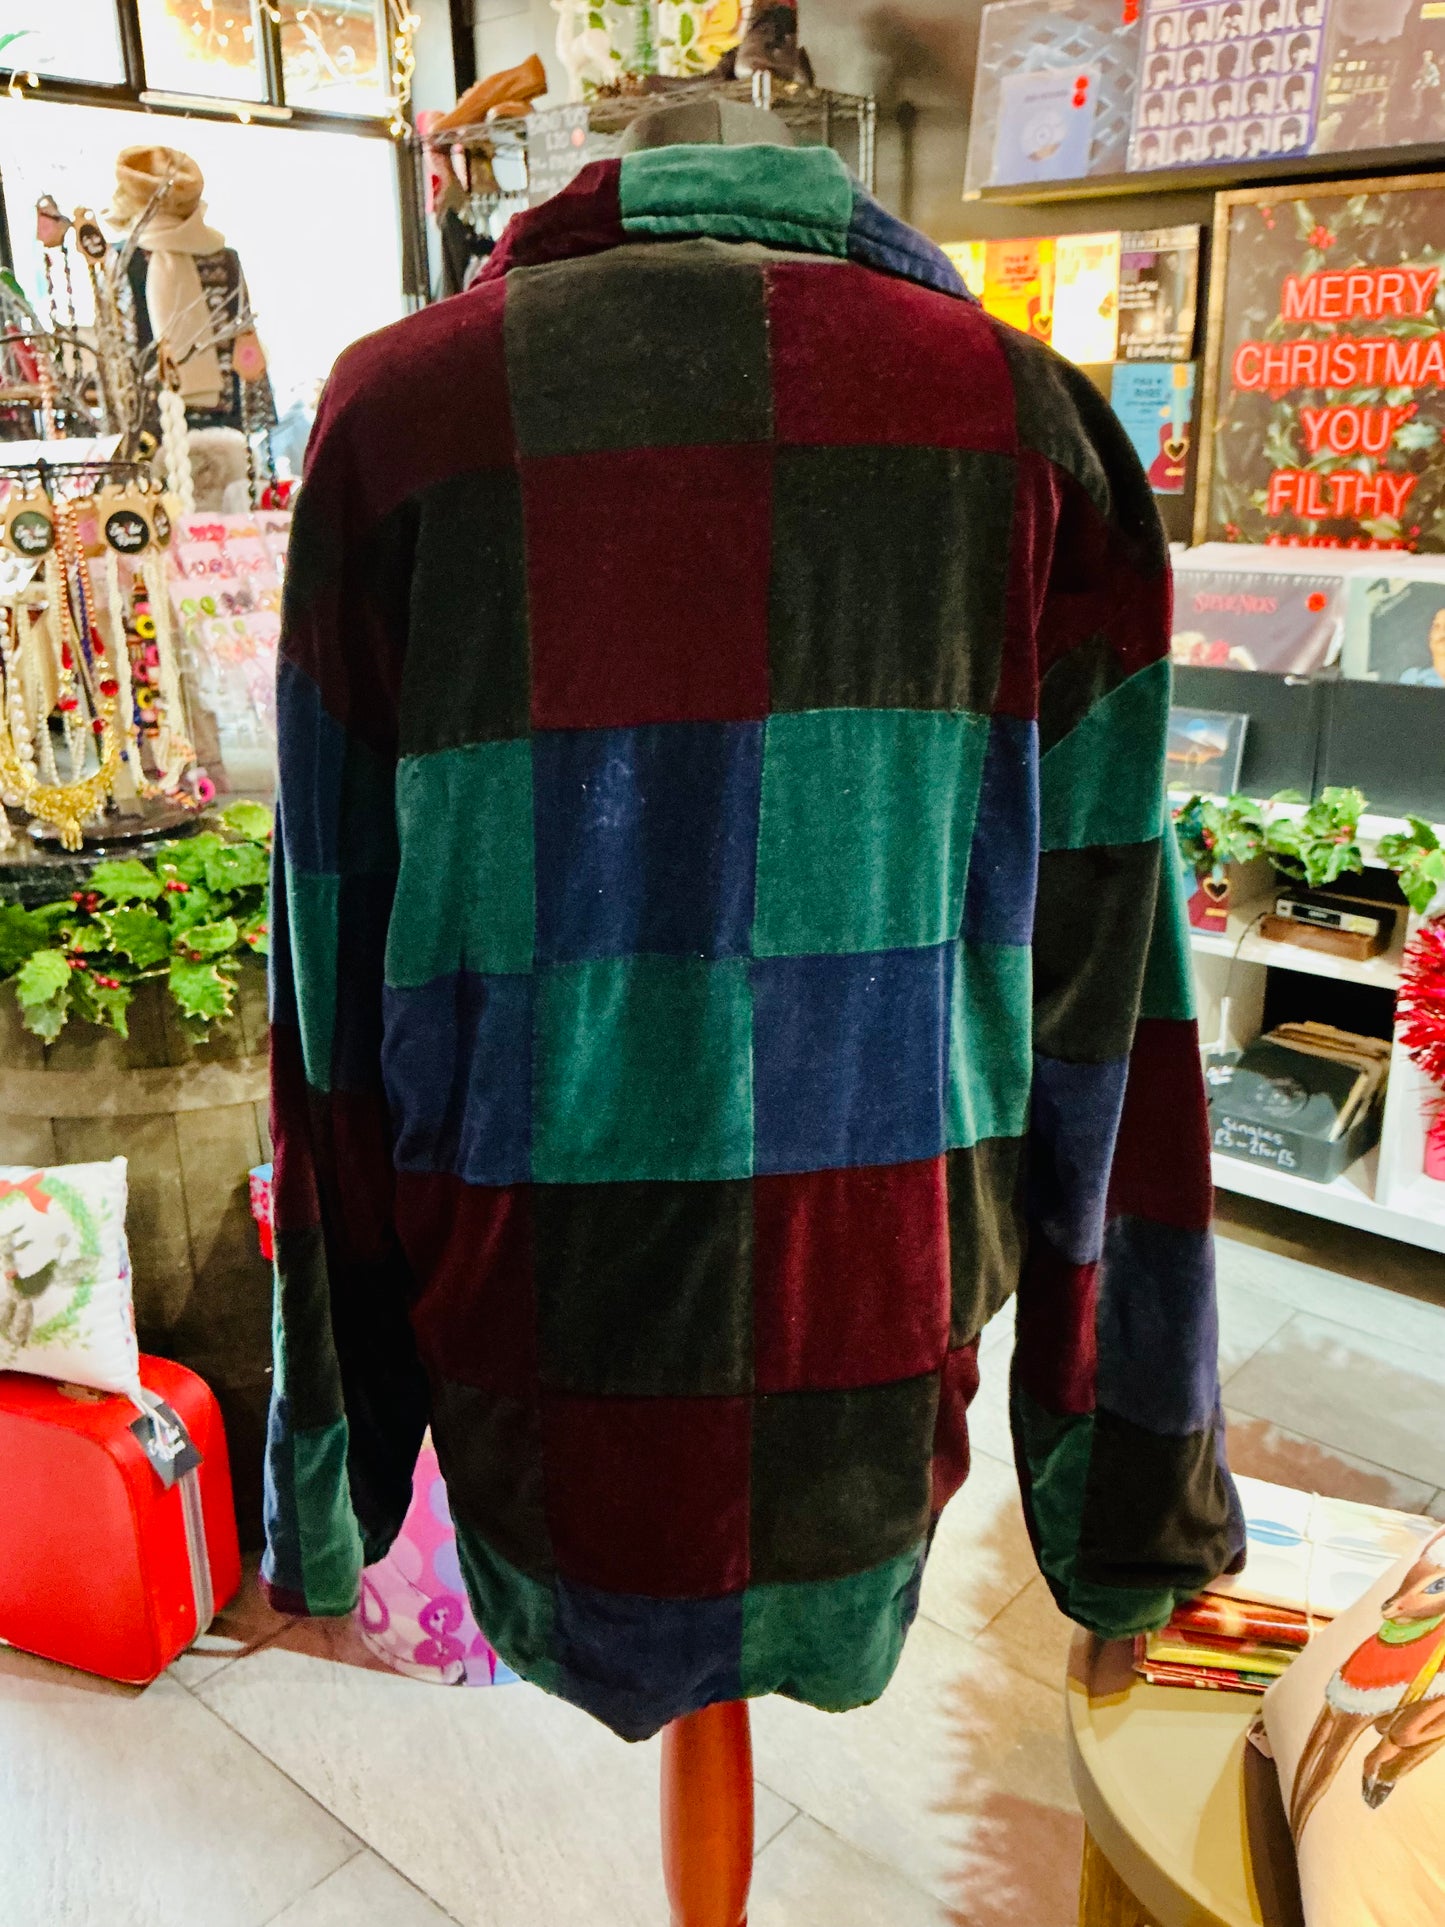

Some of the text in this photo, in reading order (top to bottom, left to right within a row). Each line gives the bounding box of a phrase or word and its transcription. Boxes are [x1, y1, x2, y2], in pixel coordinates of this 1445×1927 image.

[1282, 269, 1438, 321] MERRY
[1234, 340, 1445, 389] CHRISTMA
[1302, 408, 1393, 454] YOU
[1268, 470, 1416, 519] FILTHY
